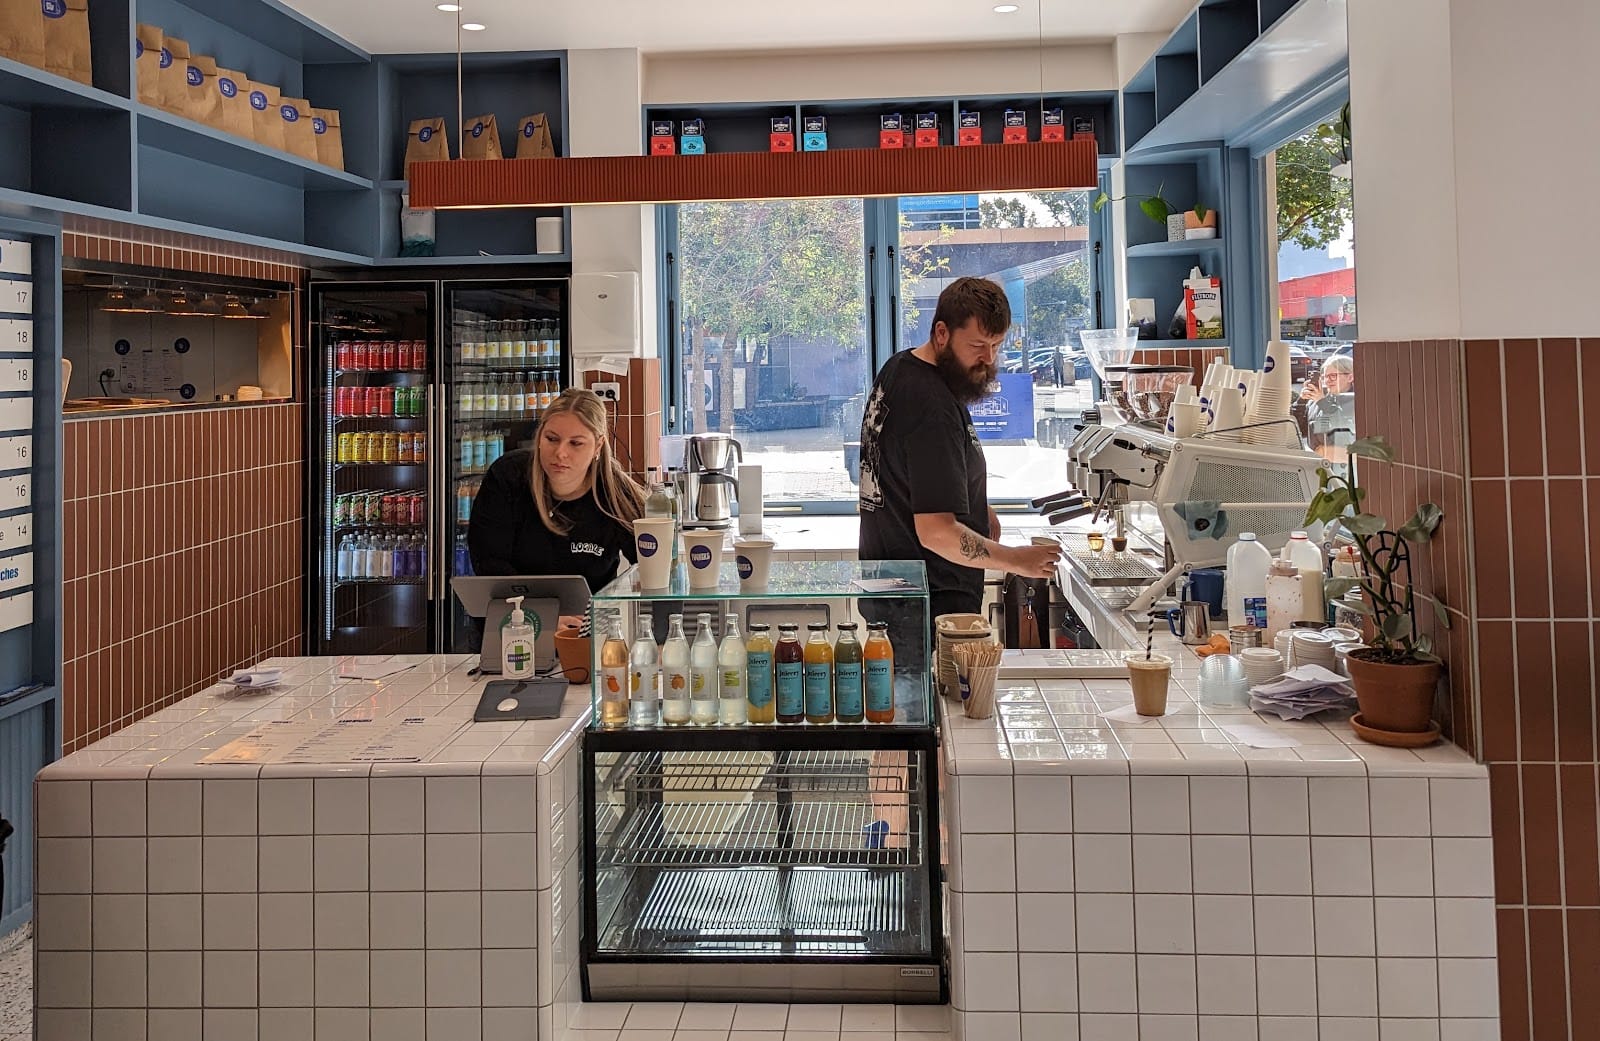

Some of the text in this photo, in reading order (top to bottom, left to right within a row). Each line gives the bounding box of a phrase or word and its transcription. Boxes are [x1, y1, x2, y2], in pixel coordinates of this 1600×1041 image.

[16, 291, 28, 303] 17
[16, 331, 28, 343] 18
[17, 369, 28, 381] 18
[16, 446, 27, 458] 16
[15, 485, 26, 497] 16
[17, 525, 27, 537] 14
[0, 567, 19, 580] ches
